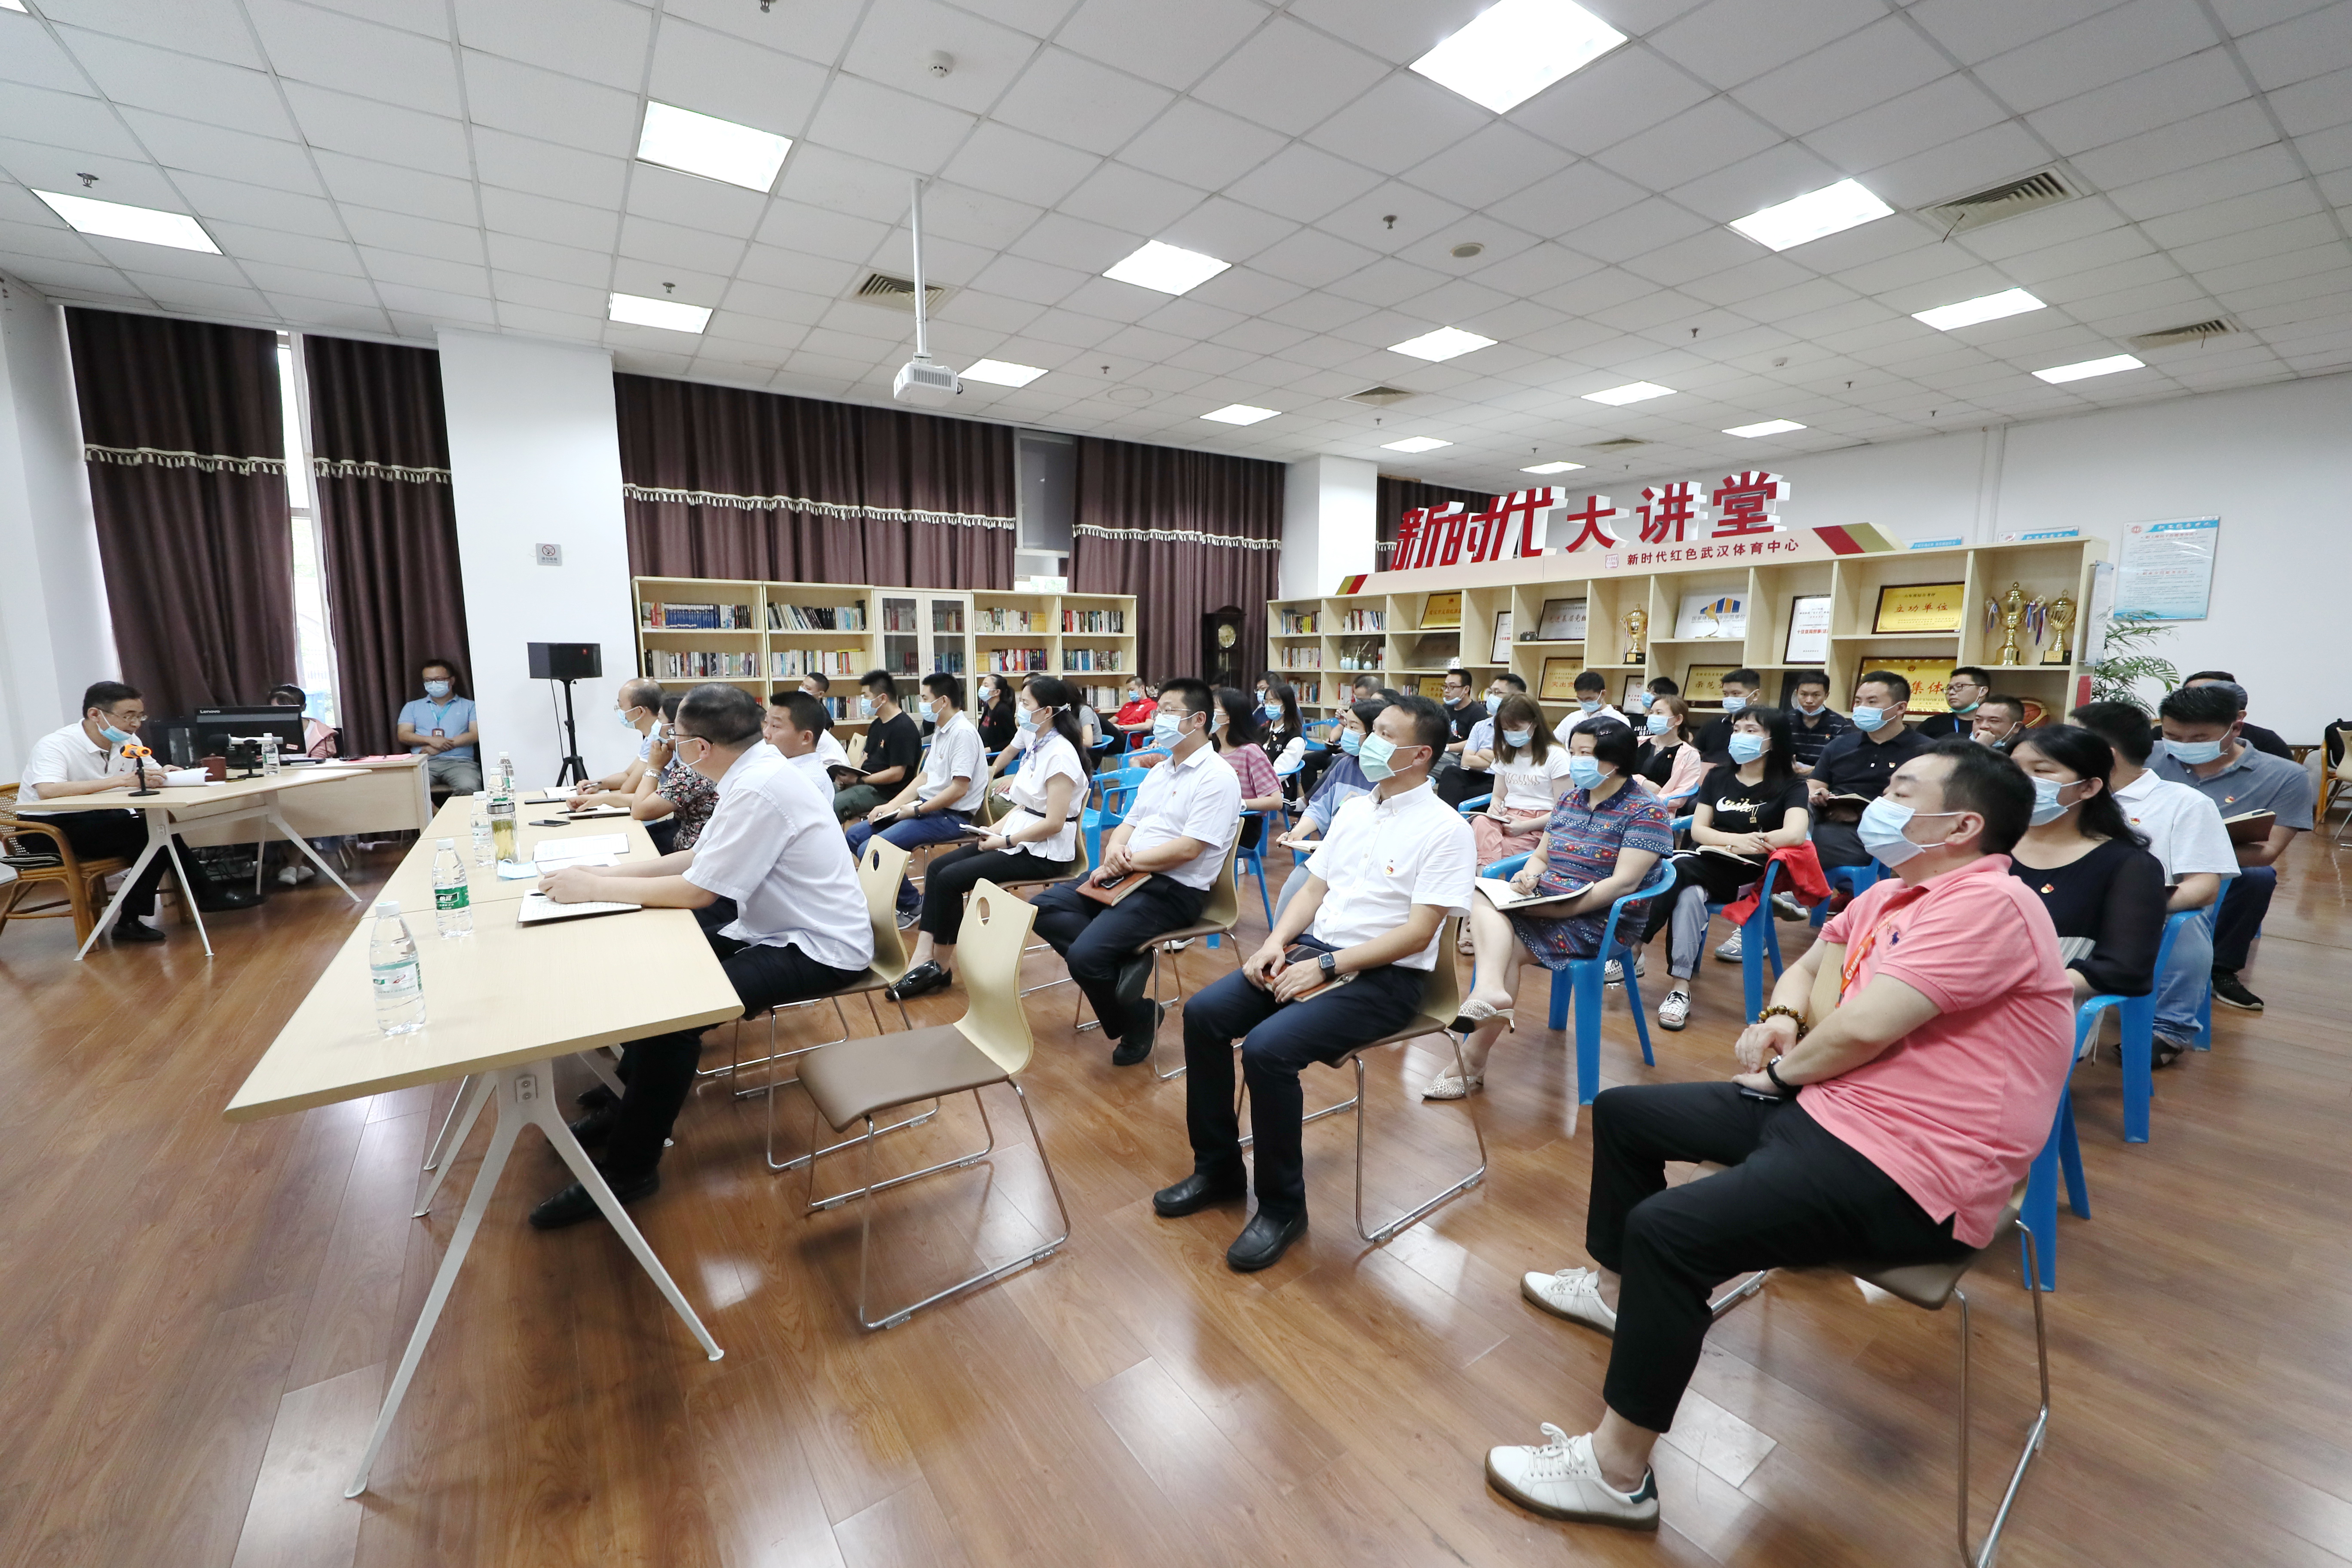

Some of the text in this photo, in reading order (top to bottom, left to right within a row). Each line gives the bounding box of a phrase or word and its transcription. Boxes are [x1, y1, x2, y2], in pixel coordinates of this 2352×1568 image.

[1390, 471, 1780, 570] 新时代大讲堂
[1627, 538, 1799, 566] 新时代红色武汉体育中心
[1894, 603, 1948, 613] 立功单位
